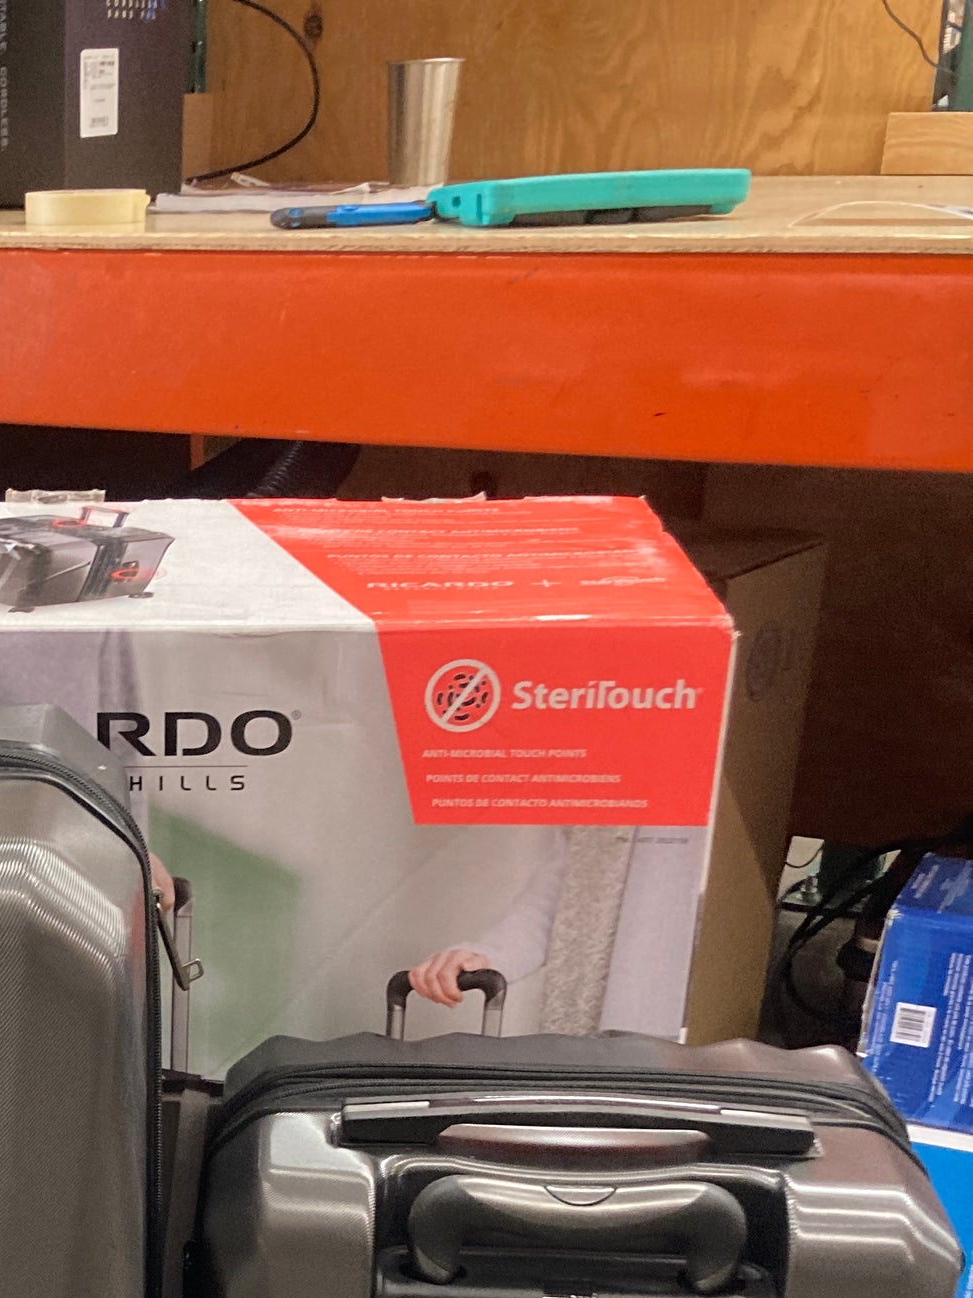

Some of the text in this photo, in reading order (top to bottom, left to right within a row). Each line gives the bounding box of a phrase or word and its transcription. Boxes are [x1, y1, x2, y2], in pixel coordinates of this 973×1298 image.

[512, 679, 697, 710] SteriTouch
[422, 749, 588, 758] ANTI-MICROBIAL TOUCH POINTS
[129, 774, 246, 792] HILLS
[426, 774, 464, 783] POINTS
[465, 774, 480, 783] DE
[476, 799, 490, 808] DE
